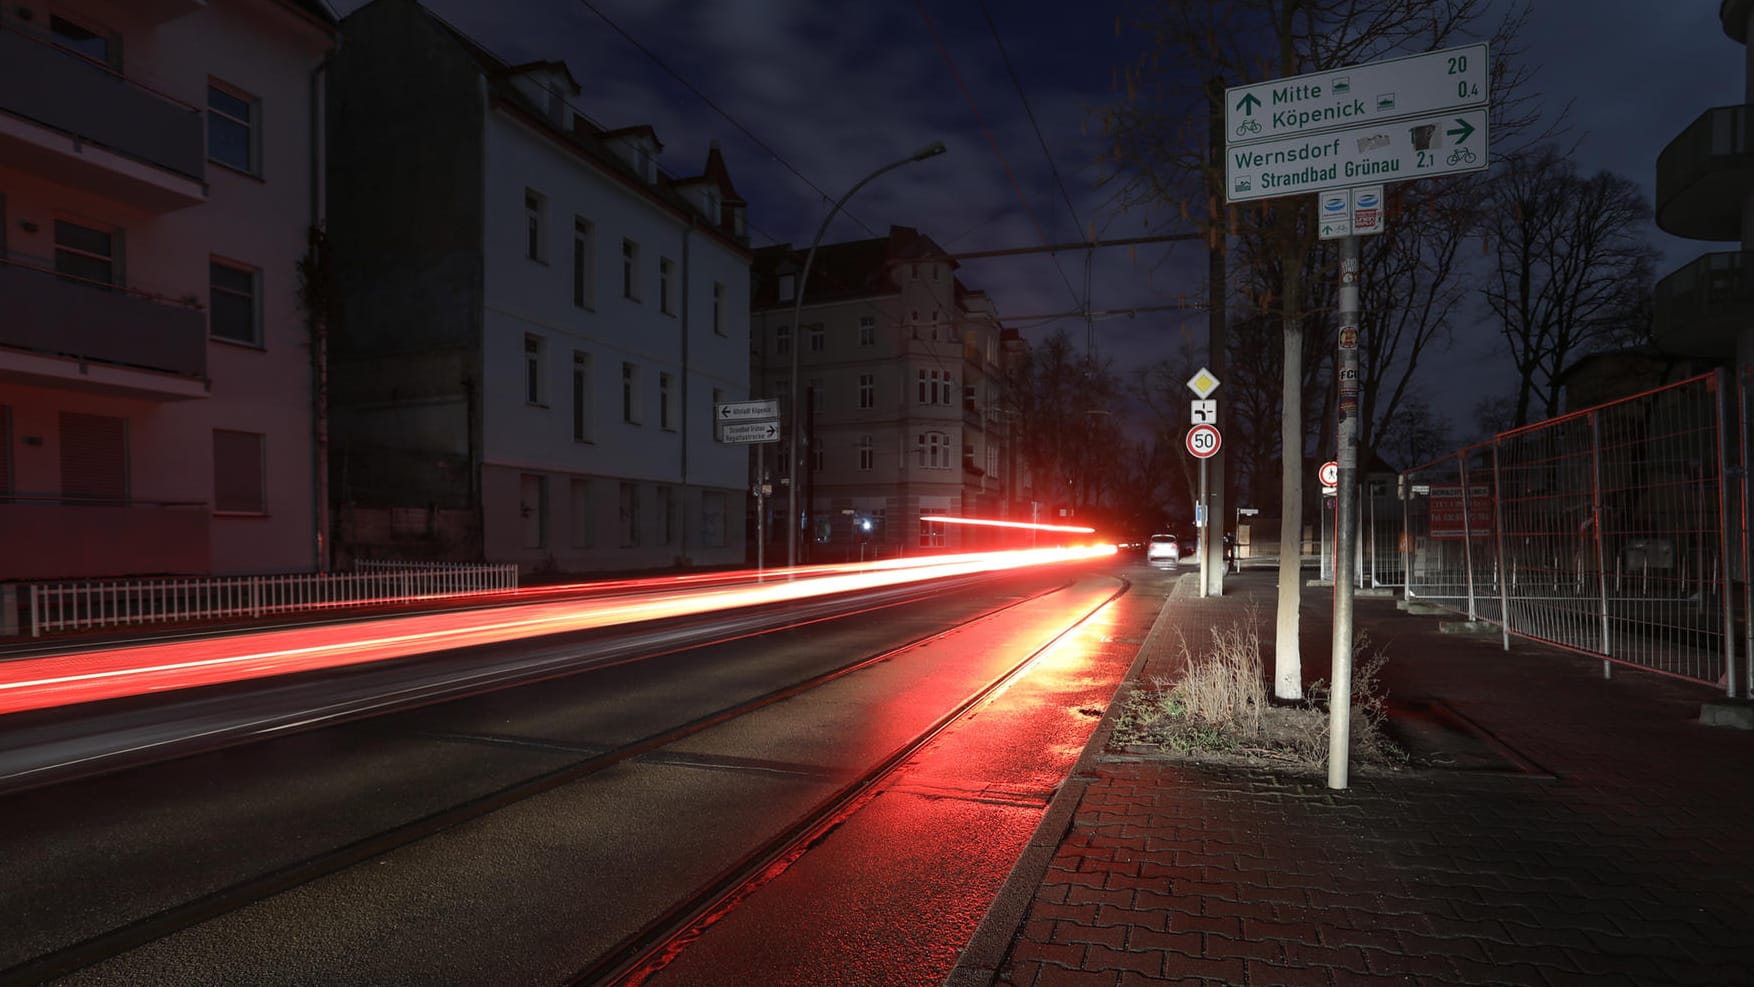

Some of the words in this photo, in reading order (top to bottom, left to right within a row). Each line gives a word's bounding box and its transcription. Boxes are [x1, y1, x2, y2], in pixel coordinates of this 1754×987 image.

[1272, 85, 1321, 105] Mitte
[1447, 55, 1467, 75] 20
[1273, 98, 1365, 128] Köpenick
[1458, 80, 1478, 98] 0.4
[1235, 139, 1340, 169] Wernsdorf
[1261, 163, 1337, 189] Strandbad
[1345, 158, 1399, 178] Grünau
[1417, 151, 1434, 168] 2.1
[1195, 433, 1213, 449] 50
